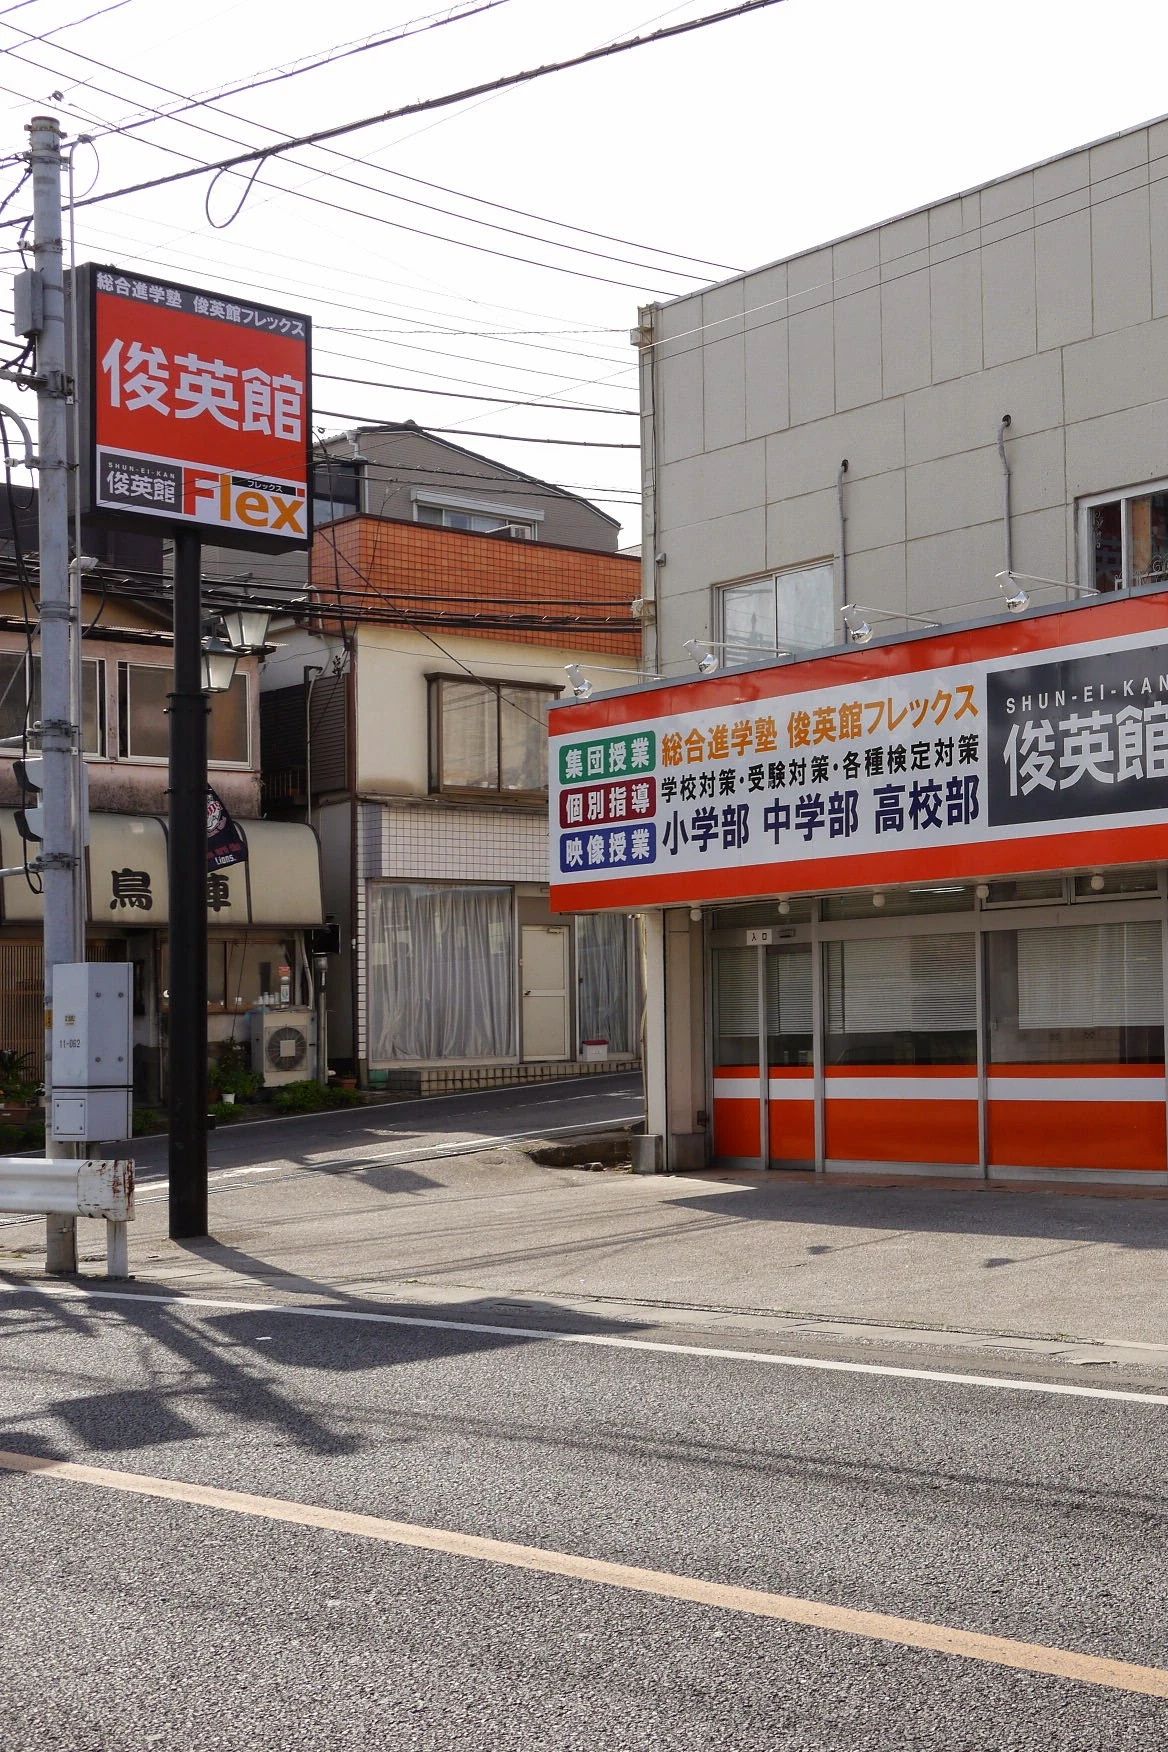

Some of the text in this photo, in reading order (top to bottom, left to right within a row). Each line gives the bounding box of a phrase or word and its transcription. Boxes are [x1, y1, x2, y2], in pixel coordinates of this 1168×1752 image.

[96, 272, 305, 337] 総合進学塾 俊英館フレックス
[102, 338, 303, 443] 俊英館
[107, 470, 176, 504] 俊英館
[108, 462, 175, 479] SHUN-EI-KAN
[247, 480, 283, 493] フレックス
[184, 467, 305, 534] Flex
[661, 684, 979, 768] 総合進学塾 俊英館フレックス
[565, 737, 650, 779] 集団授業
[565, 782, 650, 824] 個別指導
[662, 774, 980, 856] 小学部 中学部 高校部
[565, 828, 650, 868] 映像授業
[751, 932, 768, 942] 入口
